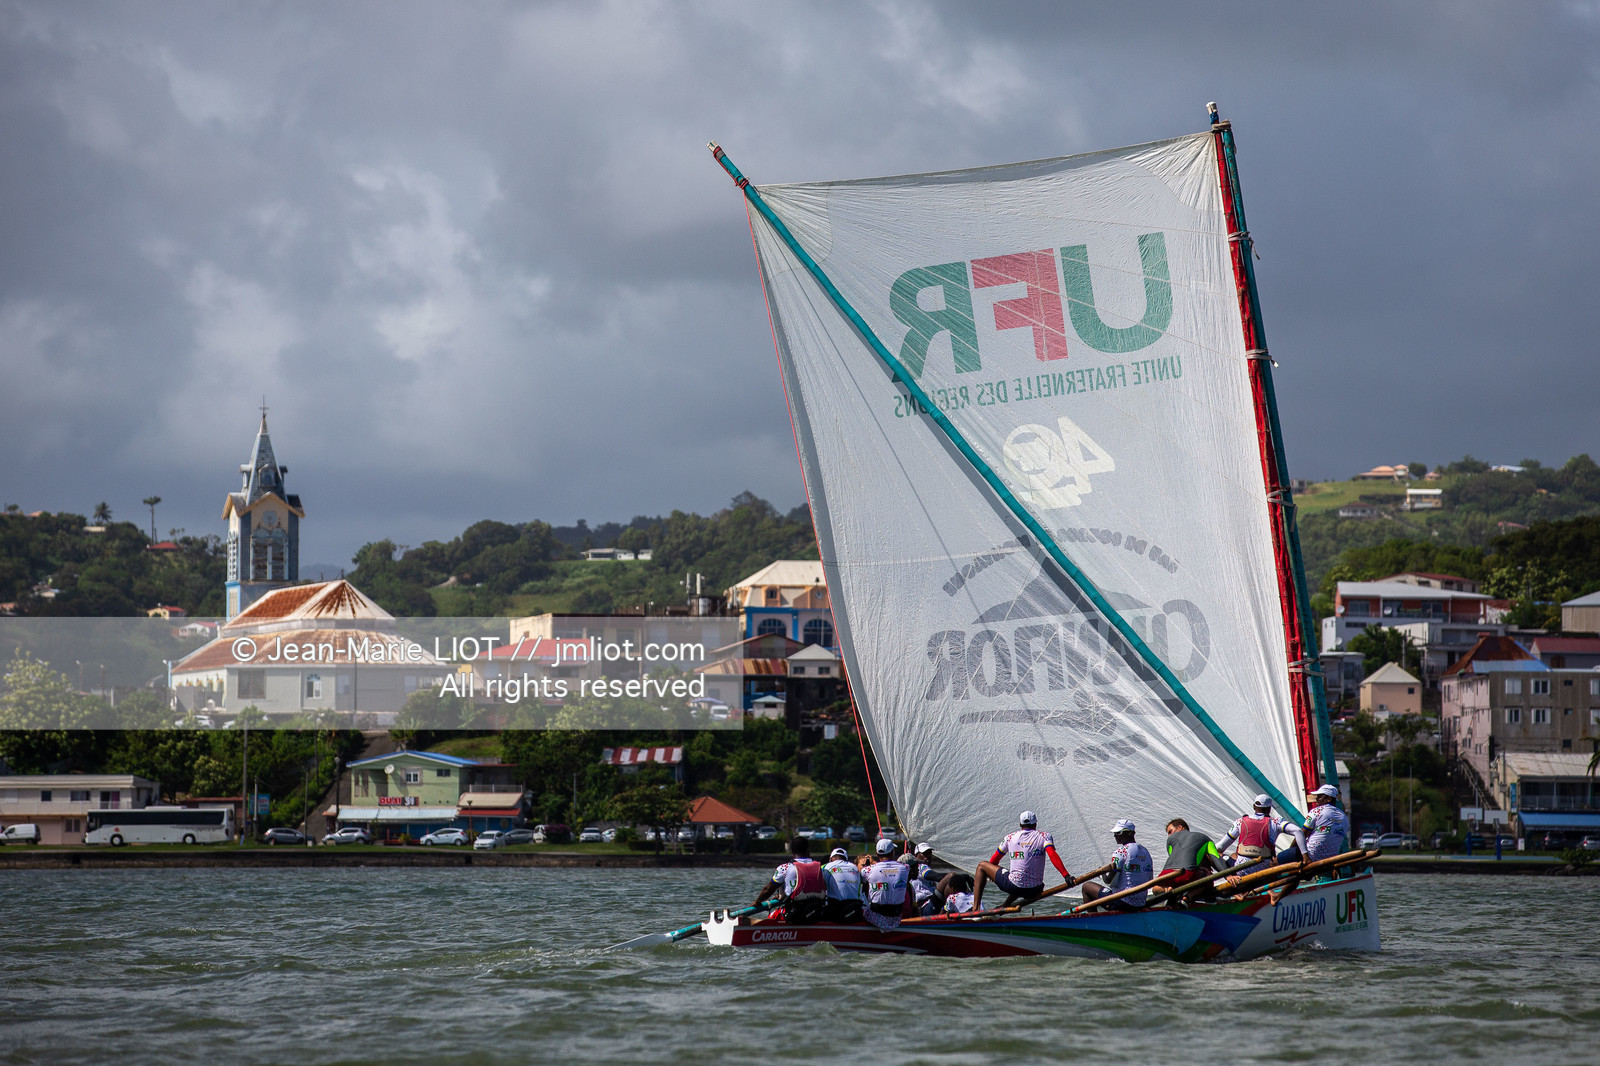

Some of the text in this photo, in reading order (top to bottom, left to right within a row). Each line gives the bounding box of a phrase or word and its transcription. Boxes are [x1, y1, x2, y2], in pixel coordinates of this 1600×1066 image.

[1010, 851, 1024, 859] UFR
[871, 882, 889, 891] UFR
[1336, 889, 1368, 925] UFR
[1272, 897, 1327, 934] CHANFLOR
[752, 930, 798, 942] CARACOLI
